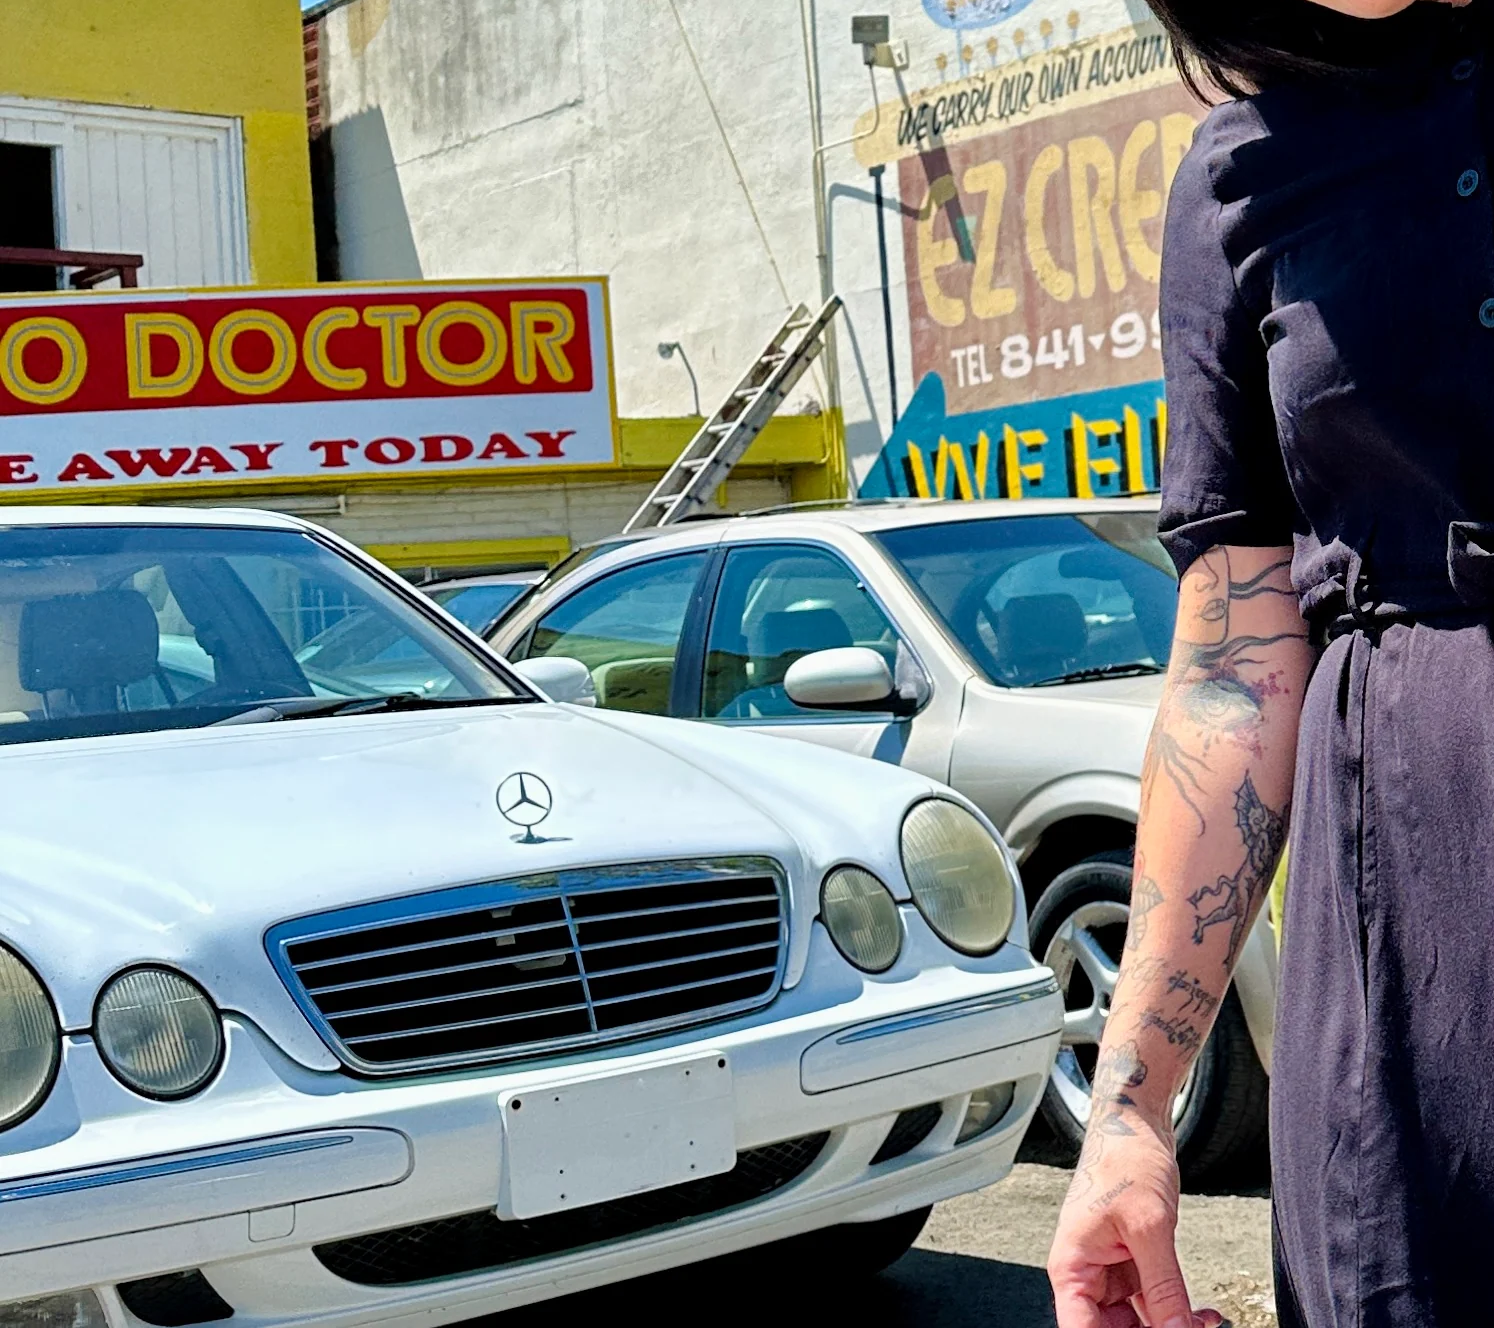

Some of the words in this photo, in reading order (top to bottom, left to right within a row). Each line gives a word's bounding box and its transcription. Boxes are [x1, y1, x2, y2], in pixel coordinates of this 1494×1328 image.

[897, 102, 929, 146] WE
[931, 83, 995, 136] CARRY
[998, 71, 1034, 119] OUR
[1037, 54, 1086, 104] OWN
[1086, 34, 1175, 90] ACCOUN
[917, 159, 1017, 327] EZ
[124, 300, 576, 399] DOCTOR
[951, 344, 994, 388] TEL
[57, 441, 284, 482] AWAY
[308, 430, 577, 468] TODAY
[1070, 398, 1168, 501] FI
